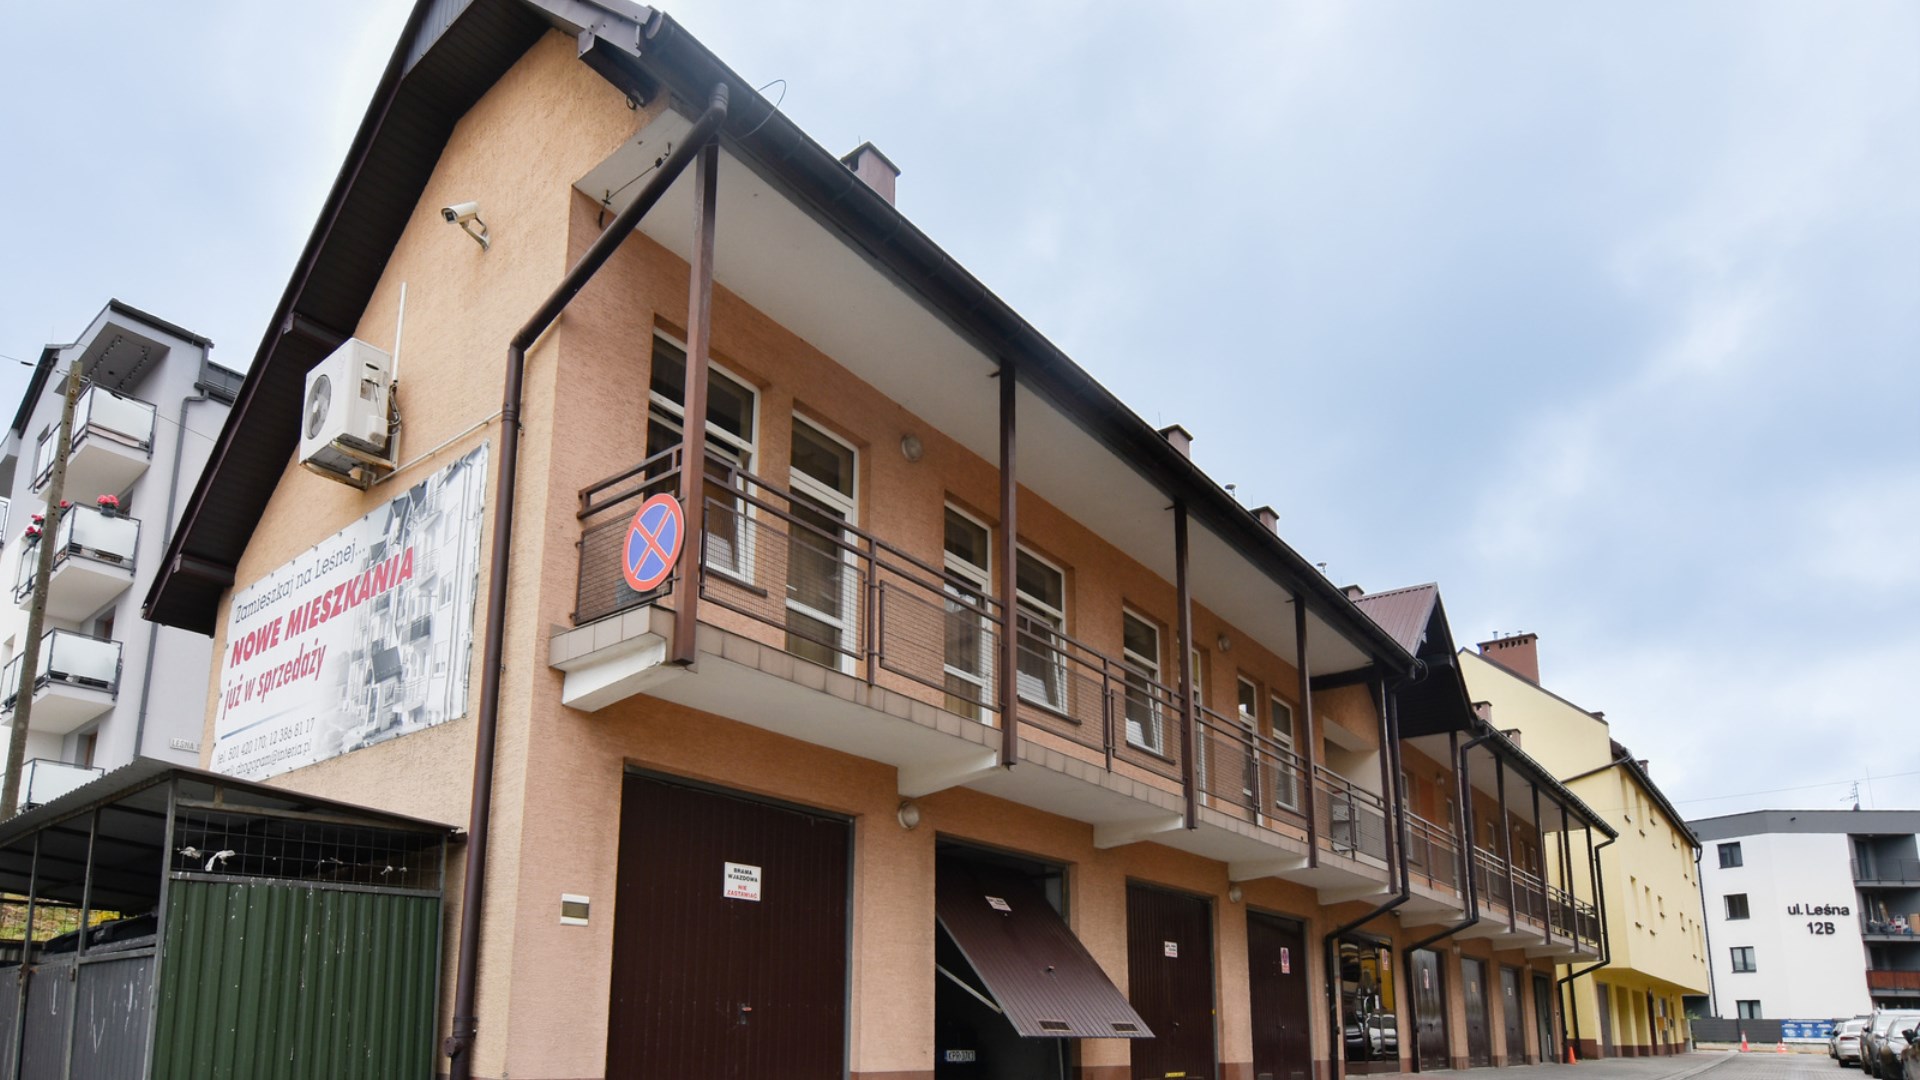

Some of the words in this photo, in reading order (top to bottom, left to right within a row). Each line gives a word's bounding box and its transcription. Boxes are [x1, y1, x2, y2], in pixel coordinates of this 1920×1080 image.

[235, 579, 294, 624] Zamieszkaj
[295, 569, 312, 589] na
[230, 616, 283, 669] NOWE
[284, 546, 413, 641] MIESZKANIA
[222, 674, 243, 720] już
[244, 677, 256, 702] w
[257, 637, 326, 703] sprzedaży
[269, 730, 278, 746] 12
[279, 725, 293, 742] 386
[305, 717, 315, 733] 17
[728, 874, 758, 882] WJAZDOWA
[733, 867, 752, 875] BRAMA
[1787, 903, 1804, 915] ul.
[1805, 903, 1850, 916] Leśna
[1807, 921, 1836, 935] 12B
